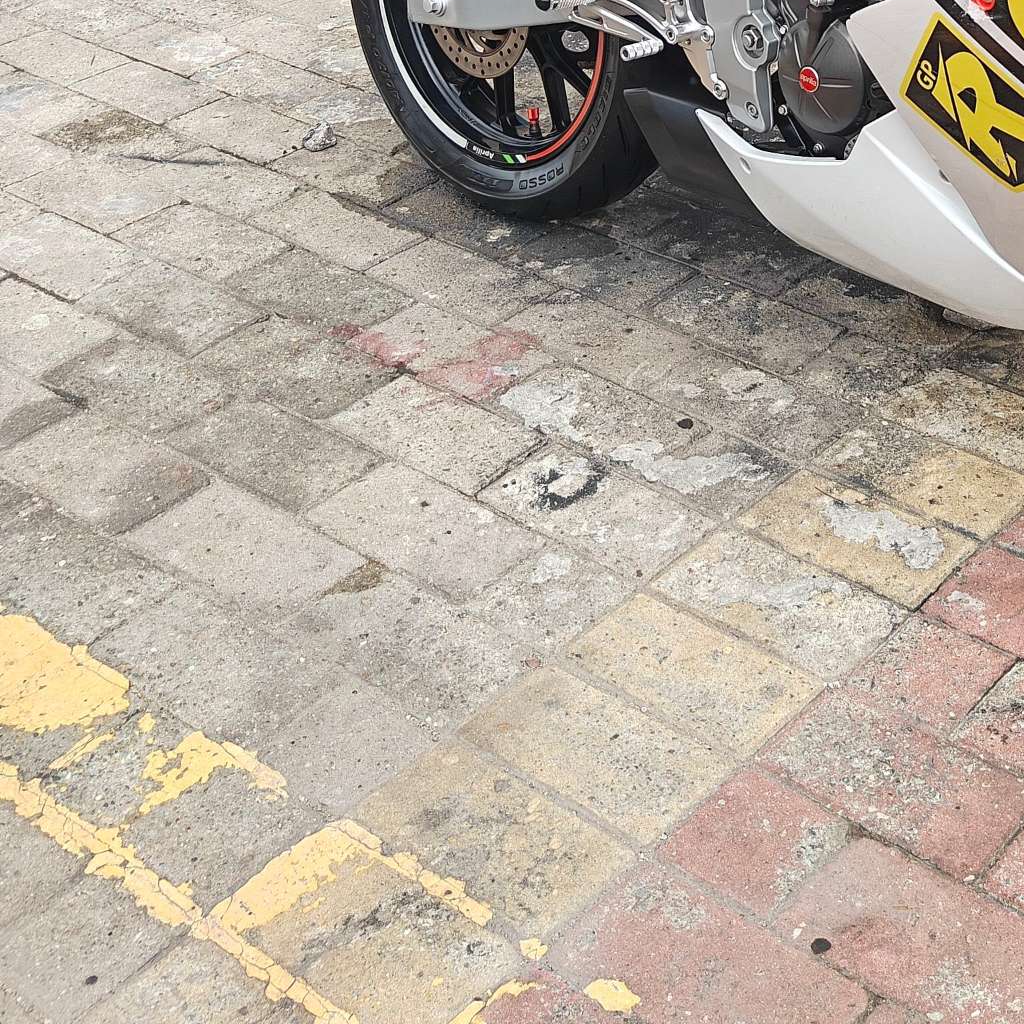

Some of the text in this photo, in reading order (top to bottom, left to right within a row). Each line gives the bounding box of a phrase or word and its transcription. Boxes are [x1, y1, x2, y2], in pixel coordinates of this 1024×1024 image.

[916, 59, 938, 91] GP
[472, 144, 495, 160] Aprilia
[518, 162, 565, 191] ROSSO
